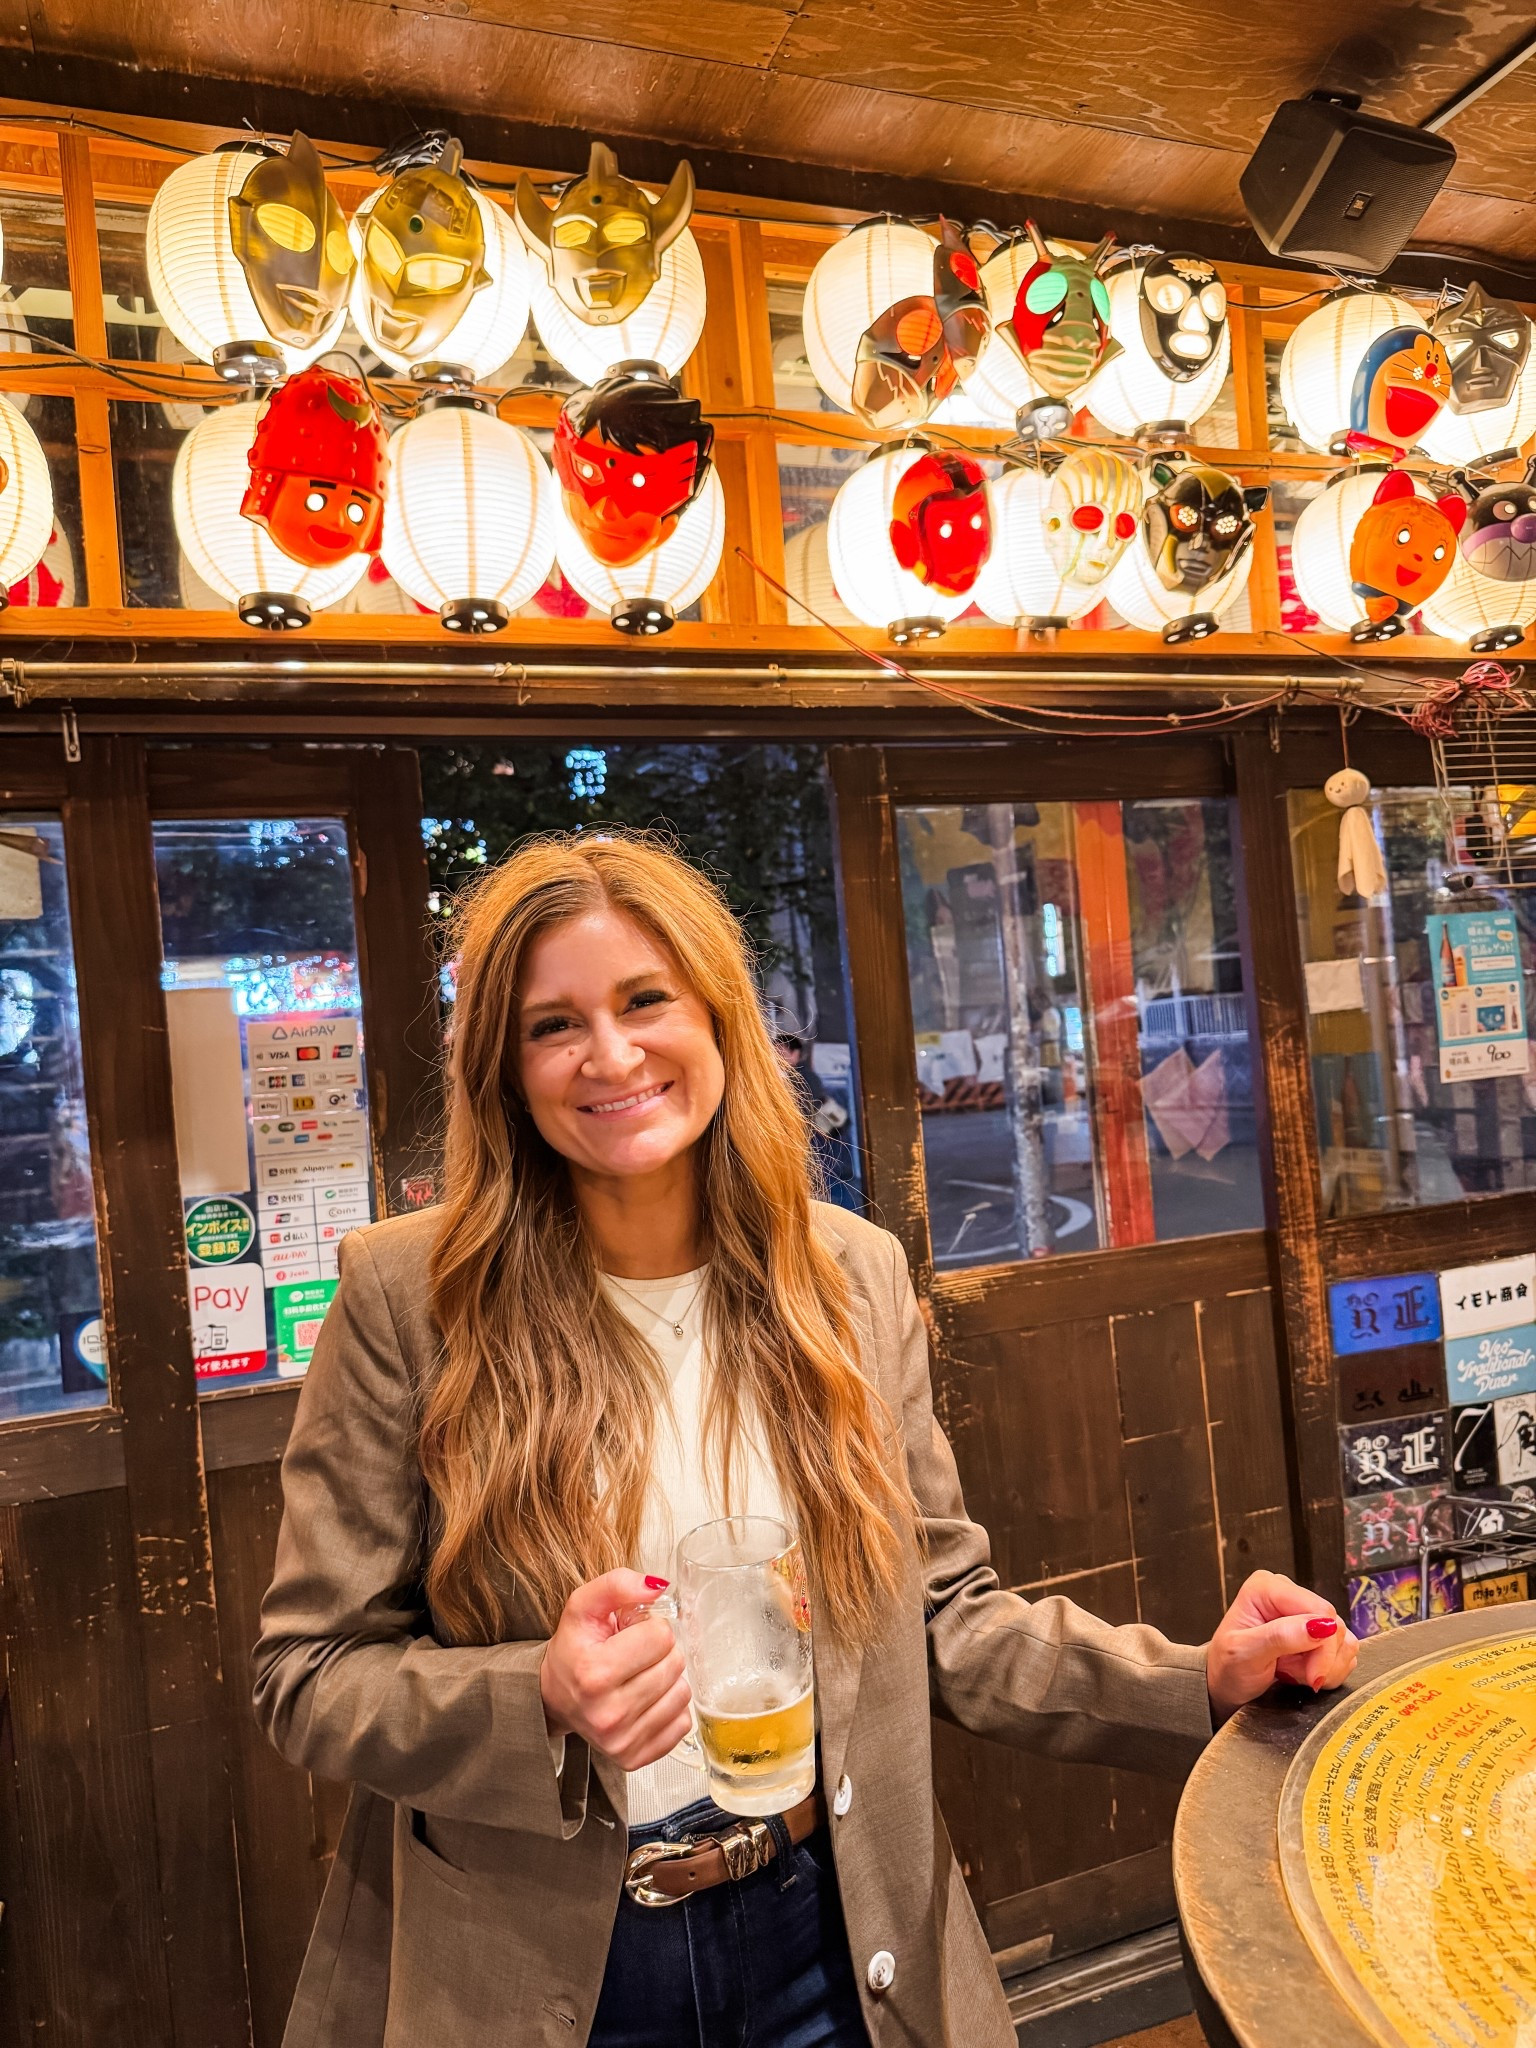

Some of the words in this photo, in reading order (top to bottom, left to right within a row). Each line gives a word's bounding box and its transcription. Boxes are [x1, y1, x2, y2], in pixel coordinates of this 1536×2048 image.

[291, 1025, 336, 1038] AirPAY
[269, 1051, 290, 1059] VISA
[1486, 1044, 1511, 1063] 900
[1478, 1338, 1514, 1359] Neo
[1456, 1349, 1536, 1382] Traditional
[1474, 1374, 1518, 1396] Diner
[1388, 1680, 1427, 1704] あまざけ
[1396, 1688, 1443, 1718] ひやしあめ
[1423, 1700, 1481, 1741] ソフトドリンク
[1452, 1708, 1499, 1739] レッドブル
